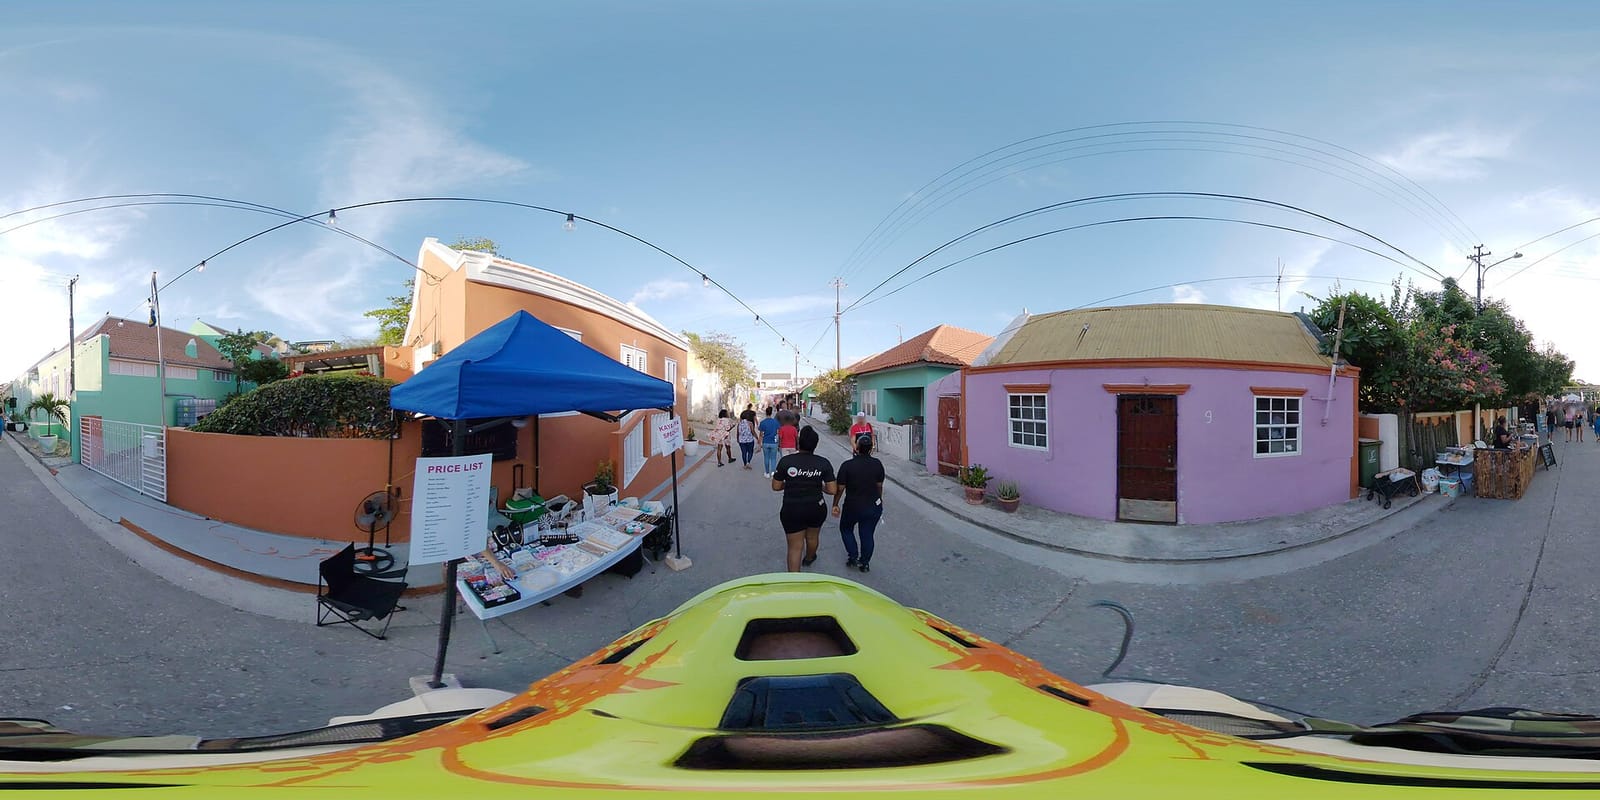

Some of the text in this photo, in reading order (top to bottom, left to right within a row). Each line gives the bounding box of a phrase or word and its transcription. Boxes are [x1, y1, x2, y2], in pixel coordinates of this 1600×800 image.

[1204, 409, 1213, 424] 9
[427, 462, 484, 474] PRICE LIST
[797, 468, 822, 478] bright
